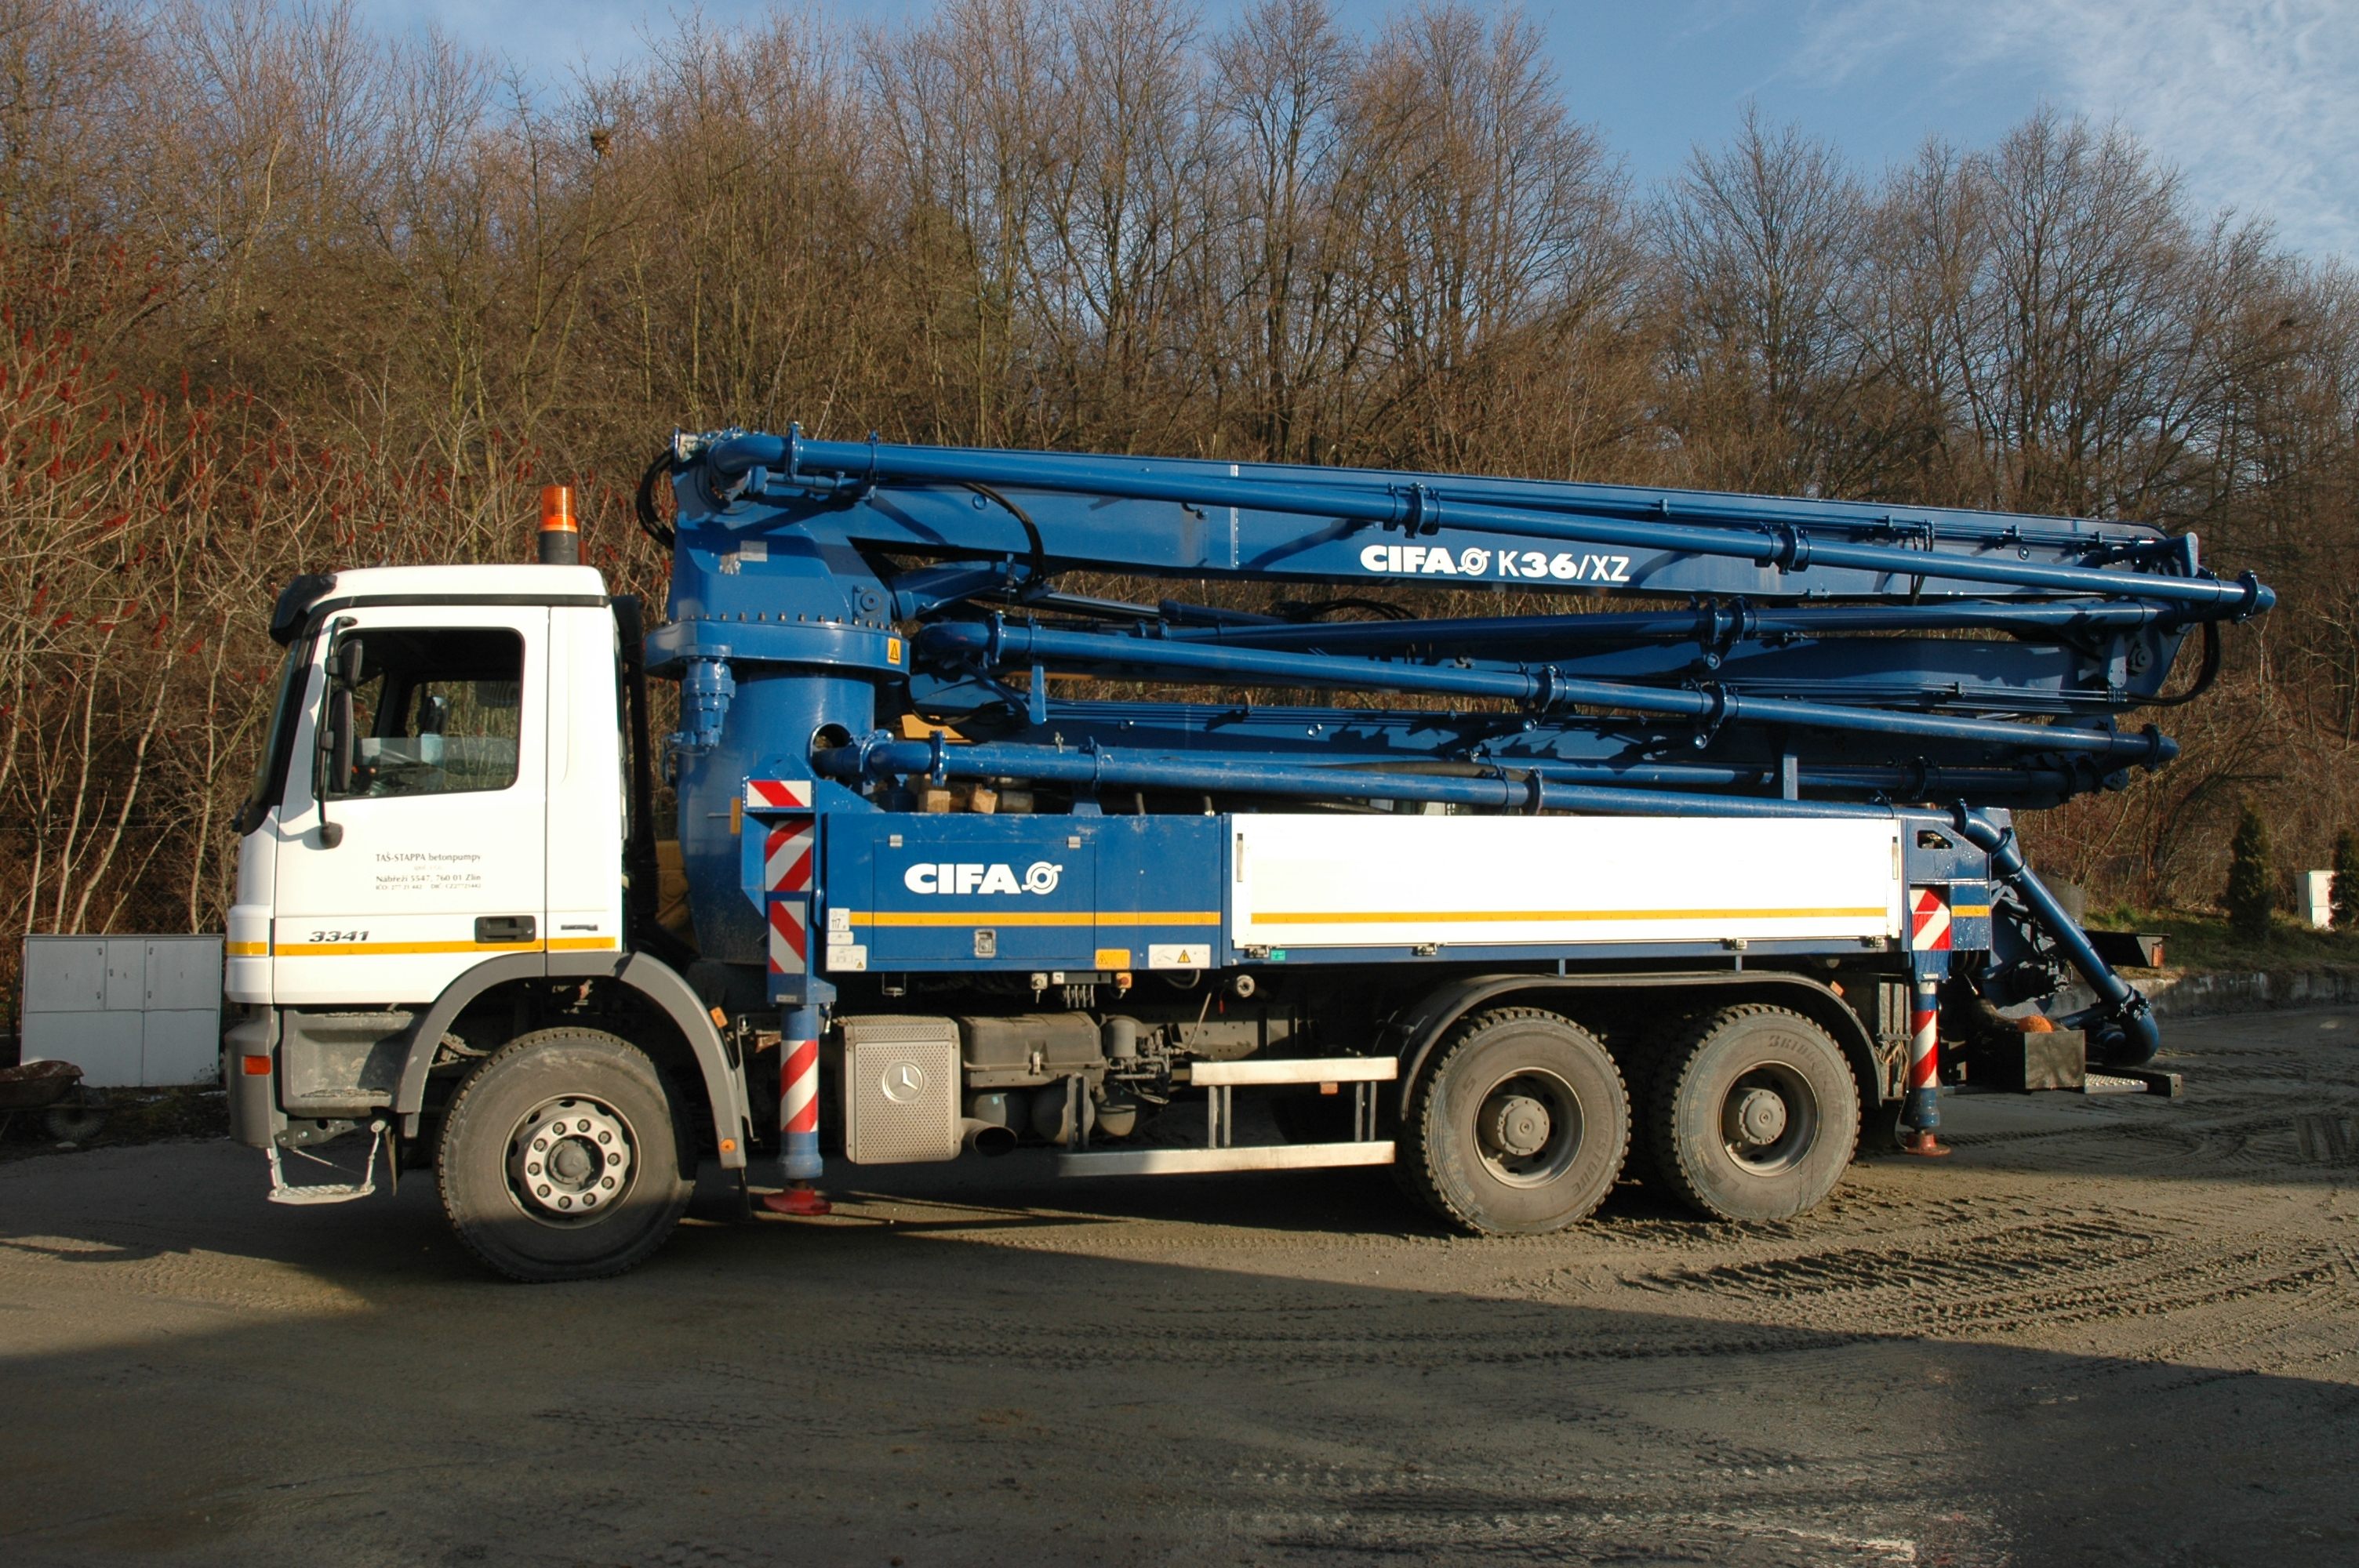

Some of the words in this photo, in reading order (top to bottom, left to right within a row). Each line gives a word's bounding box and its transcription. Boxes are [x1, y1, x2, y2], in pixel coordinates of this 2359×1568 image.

[1360, 545, 1457, 574] CIFA
[1499, 550, 1630, 582] K36/XZ
[376, 851, 426, 862] TAŠ-STAPPA
[428, 853, 481, 862] betonpumpy
[904, 863, 1022, 894] CIFA
[309, 931, 369, 942] 3341
